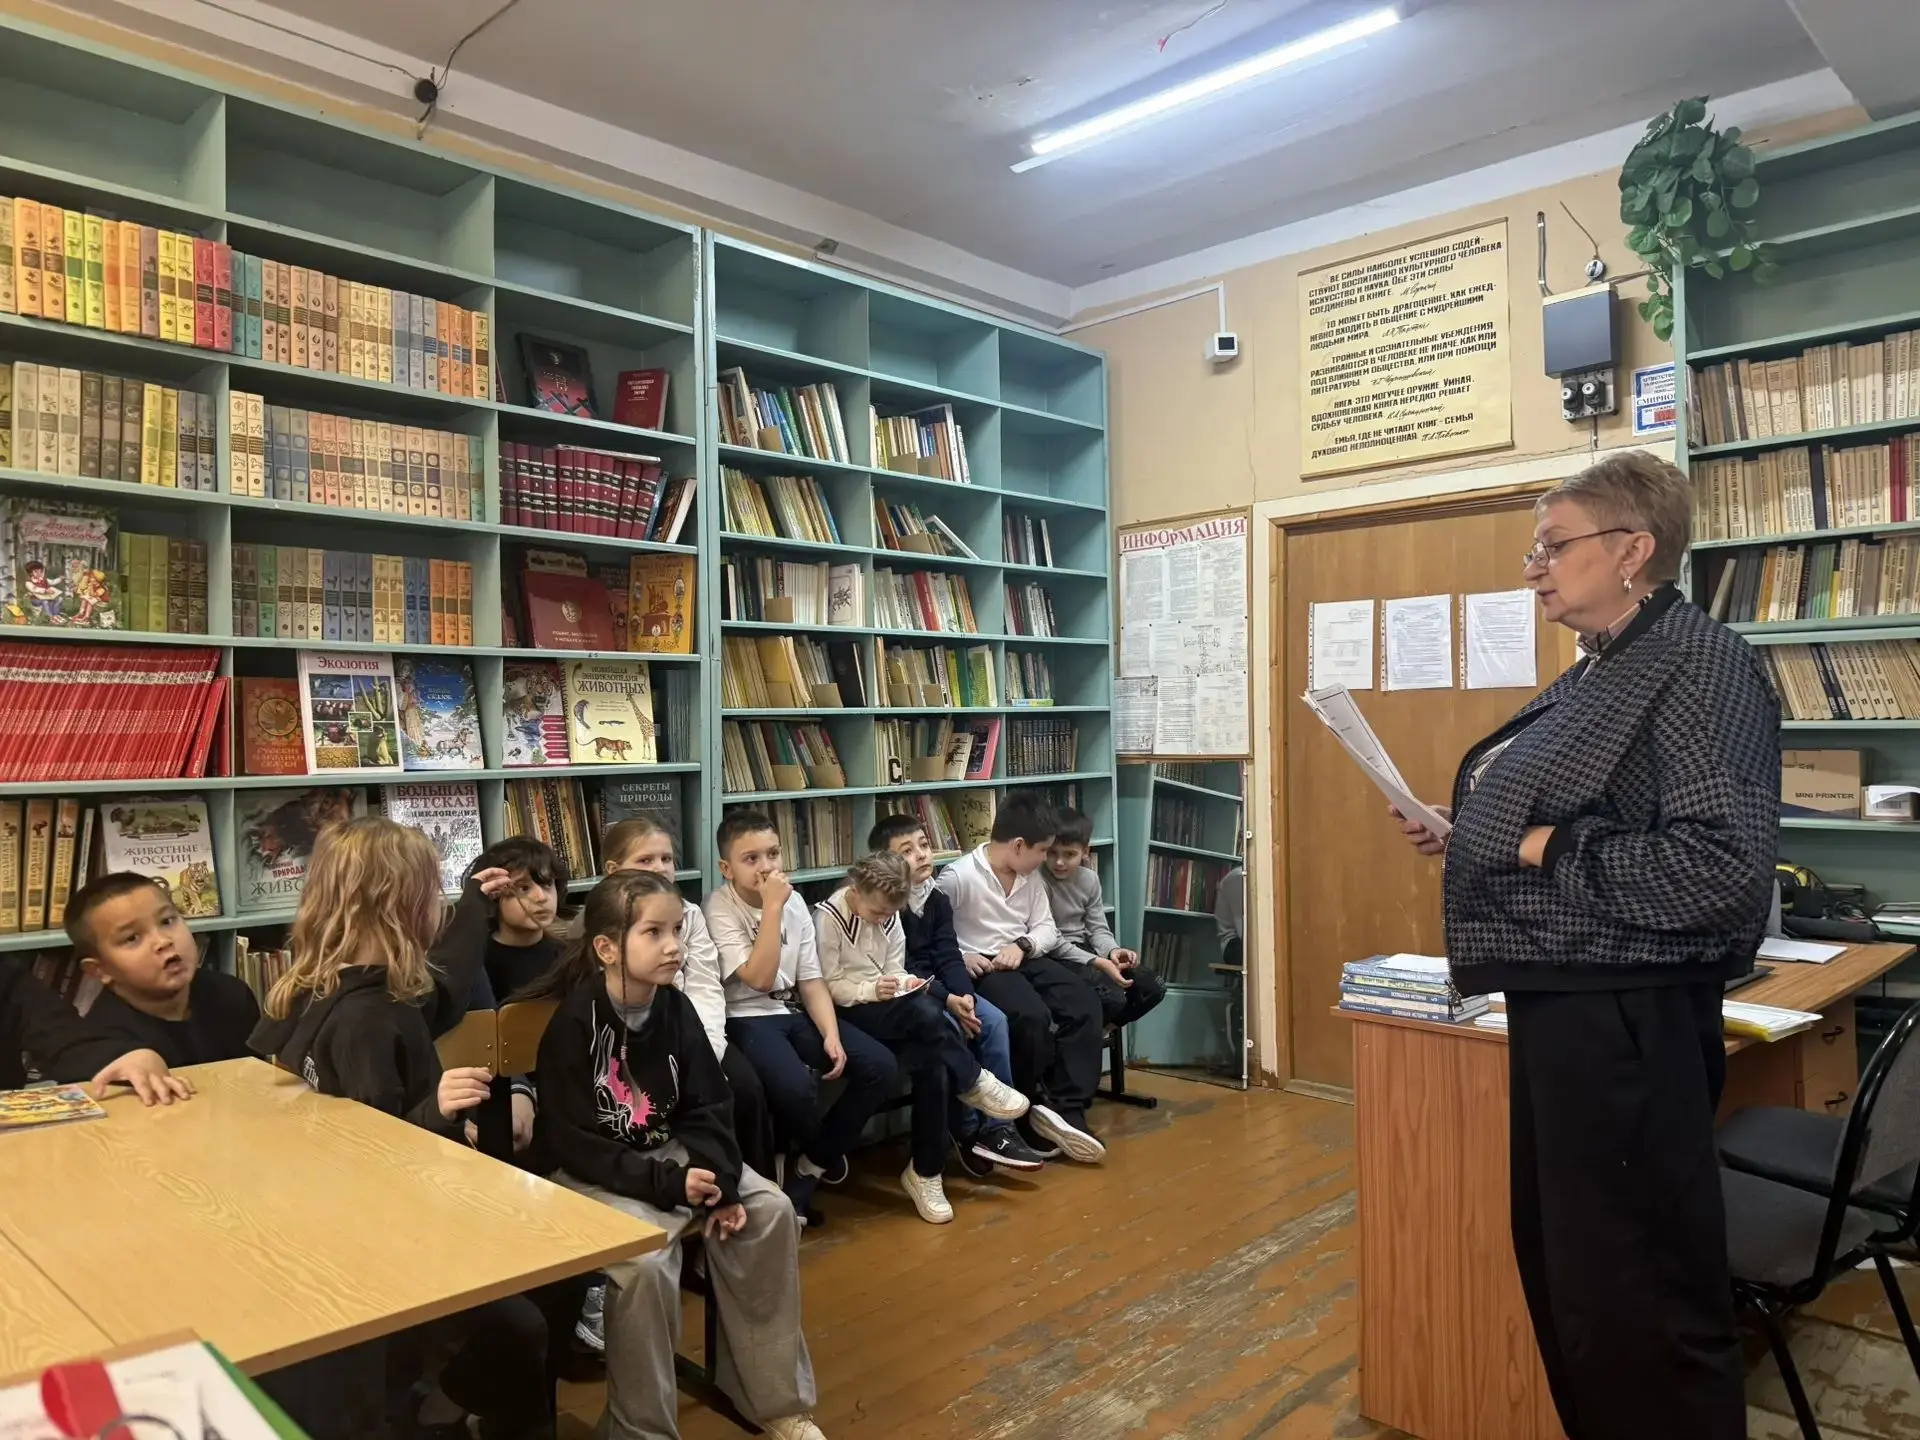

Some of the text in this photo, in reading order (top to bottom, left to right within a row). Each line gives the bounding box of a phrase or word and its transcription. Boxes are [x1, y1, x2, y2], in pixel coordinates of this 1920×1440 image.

[1342, 267, 1365, 280] СИЛЫ
[1367, 256, 1407, 273] НАИБОЛЕЕ
[1410, 246, 1450, 264] УСПЕШНО
[1452, 238, 1484, 253] СОДЕЙ-
[1309, 242, 1502, 297] СТВУЮТ ВОСПИТАНИЮ КУЛЬТУРНОГО ЧЕЛОВЕКА
[1310, 287, 1355, 306] ИСКУССТВО
[1357, 286, 1362, 294] И
[1410, 270, 1426, 281] ЭТИ
[1428, 264, 1453, 276] СИЛЫ
[1310, 297, 1357, 315] СОЕДИНЕНЫ
[1338, 313, 1365, 326] МОЖЕТ
[1368, 308, 1390, 319] БЫТЬ
[1451, 290, 1466, 302] КАК
[1469, 284, 1496, 298] ЕЖЕД-
[1310, 330, 1334, 342] НЕВНО
[1336, 321, 1371, 337] ВХОДИТЬ
[1381, 310, 1418, 325] ОБЩЕНИЕ
[1427, 295, 1484, 314] МУДРЕЙШИМИ
[1311, 336, 1345, 351] ЛЮДЬМИ
[1376, 334, 1438, 354] СОЗНАТЕЛЬНЫЕ
[1441, 322, 1493, 340] УБЕЖДЕНИЯ
[1311, 359, 1368, 377] РАЗВИВАЮТСЯ
[1378, 348, 1417, 362] ЧЕЛОВЕКЕ
[1419, 346, 1429, 354] НЕ
[1460, 336, 1476, 347] КАК
[1479, 332, 1497, 344] ИЛИ
[1311, 341, 1497, 386] ПОД ВЛИЯНИЕМ ОБЩЕСТВА, ИЛИ ПРИ ПОМОЩИ
[1312, 385, 1471, 421] ВДОХНОВЕННАЯ КНИГА НЕРЕДКО РЕШАЕТ
[1356, 395, 1370, 404] ЭТО
[1372, 388, 1404, 401] МОГУЧЕЕ
[1312, 419, 1341, 431] СУДЬБУ
[1359, 431, 1371, 440] ГДЕ
[1373, 429, 1382, 437] НЕ
[1384, 423, 1415, 435] ЧИТАЮТ
[1417, 419, 1438, 429] КНИГ
[1445, 414, 1474, 424] СЕМЬЯ
[1312, 445, 1348, 458] ДУХОВНО
[1123, 519, 1245, 549] ИНФОРМАЦИЯ
[581, 673, 638, 681] ЭНЦИКЛОПЕДИЯ
[578, 681, 645, 694] ЖИВОТНЫХ
[396, 785, 476, 796] БОЛЬШАЯ
[621, 783, 670, 791] СЕКРЕТЫ
[620, 794, 672, 802] ПРИРОДЫ
[124, 844, 199, 856] ЖИВОТНЫЕ
[133, 854, 192, 865] РОССИИ
